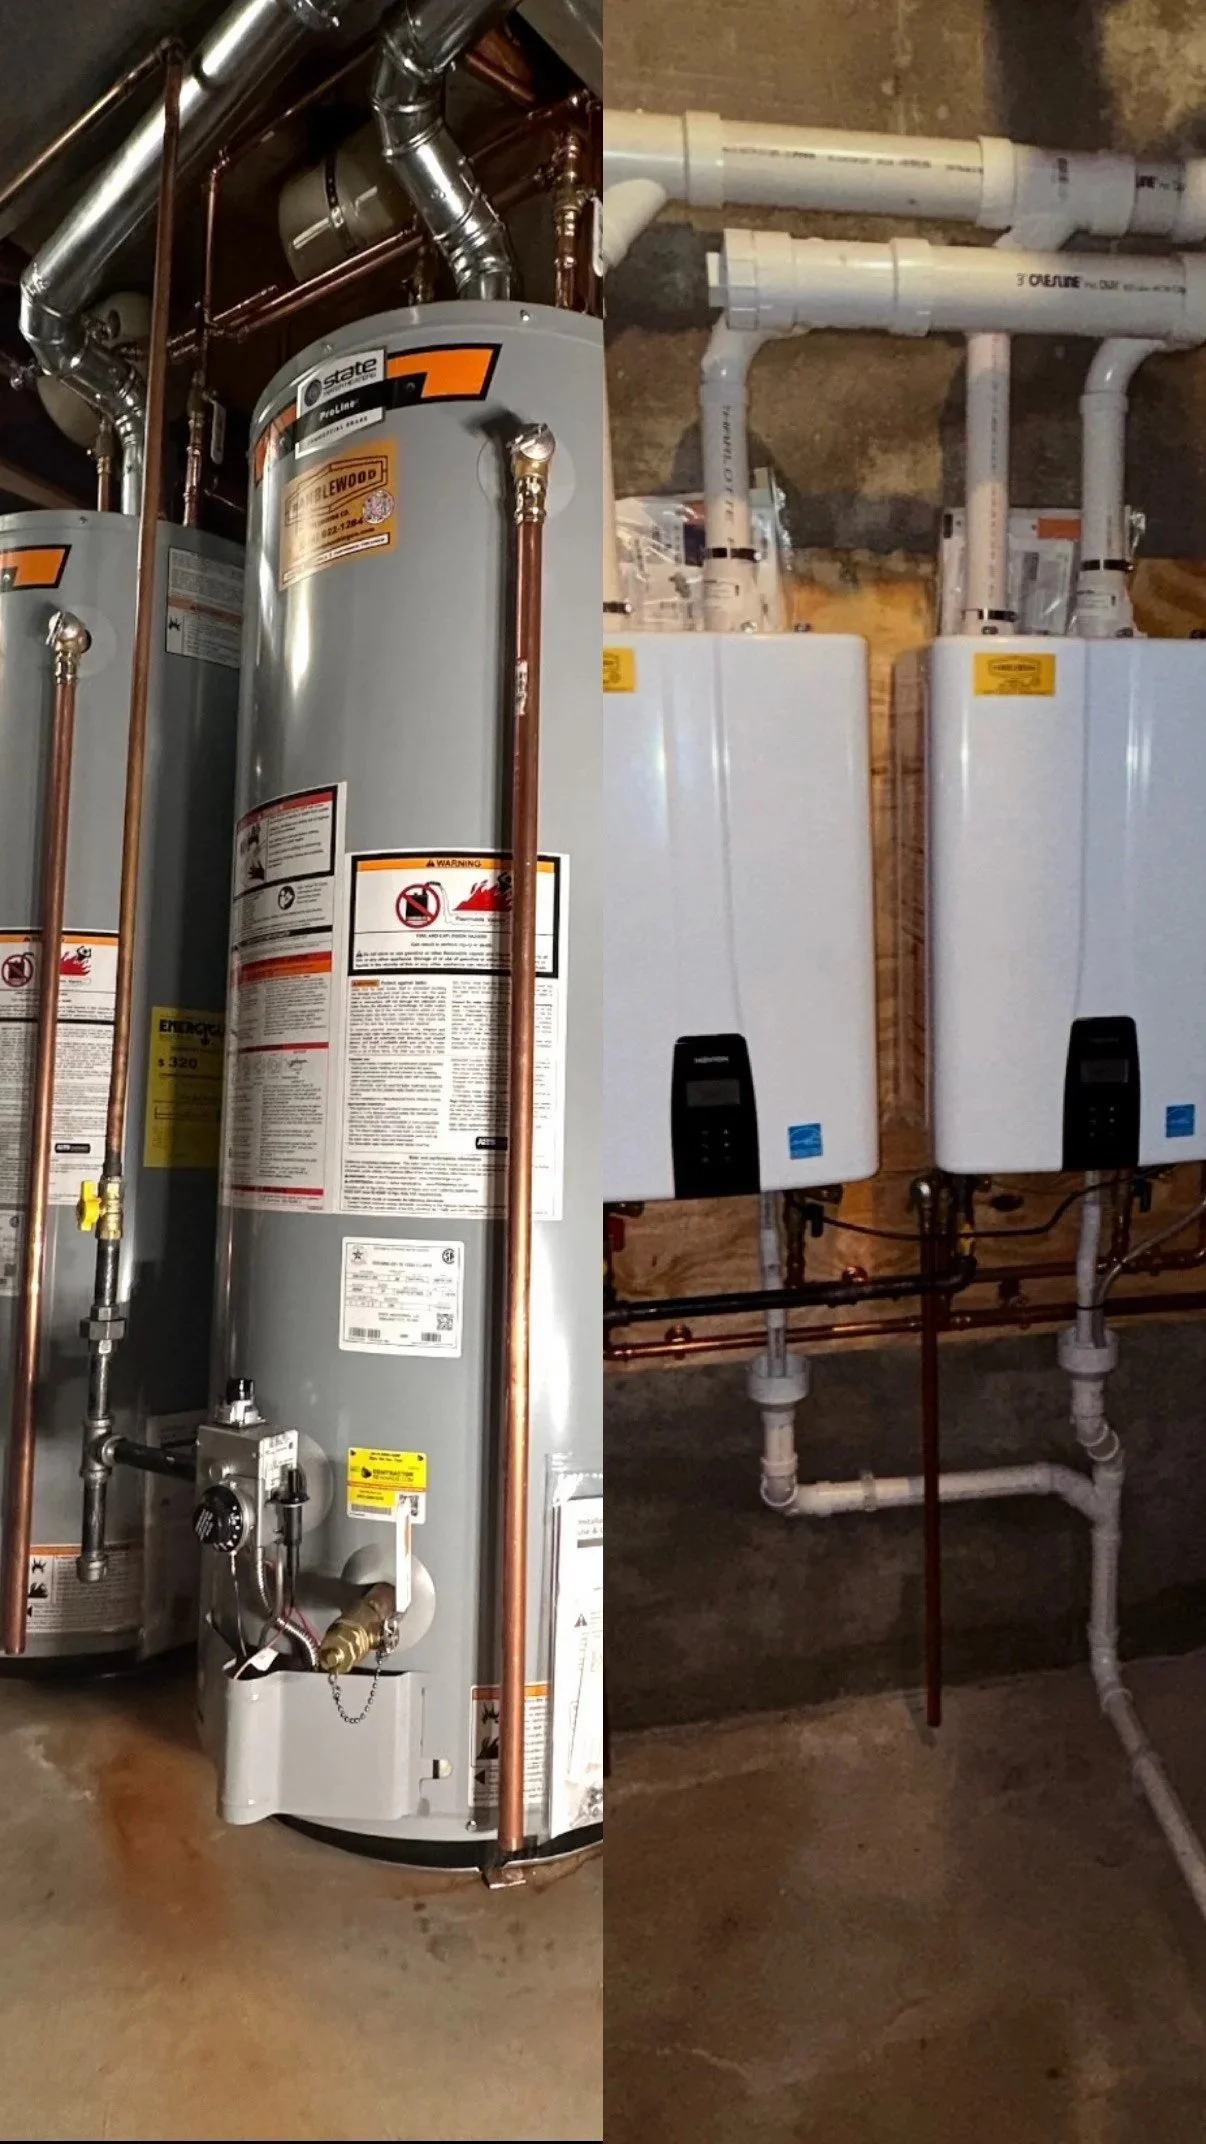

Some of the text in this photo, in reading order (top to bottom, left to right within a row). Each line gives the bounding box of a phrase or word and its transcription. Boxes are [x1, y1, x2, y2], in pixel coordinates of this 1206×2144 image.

[323, 358, 378, 390] state
[319, 399, 356, 422] ProLine
[436, 859, 483, 868] WARNING
[169, 1056, 198, 1070] 320
